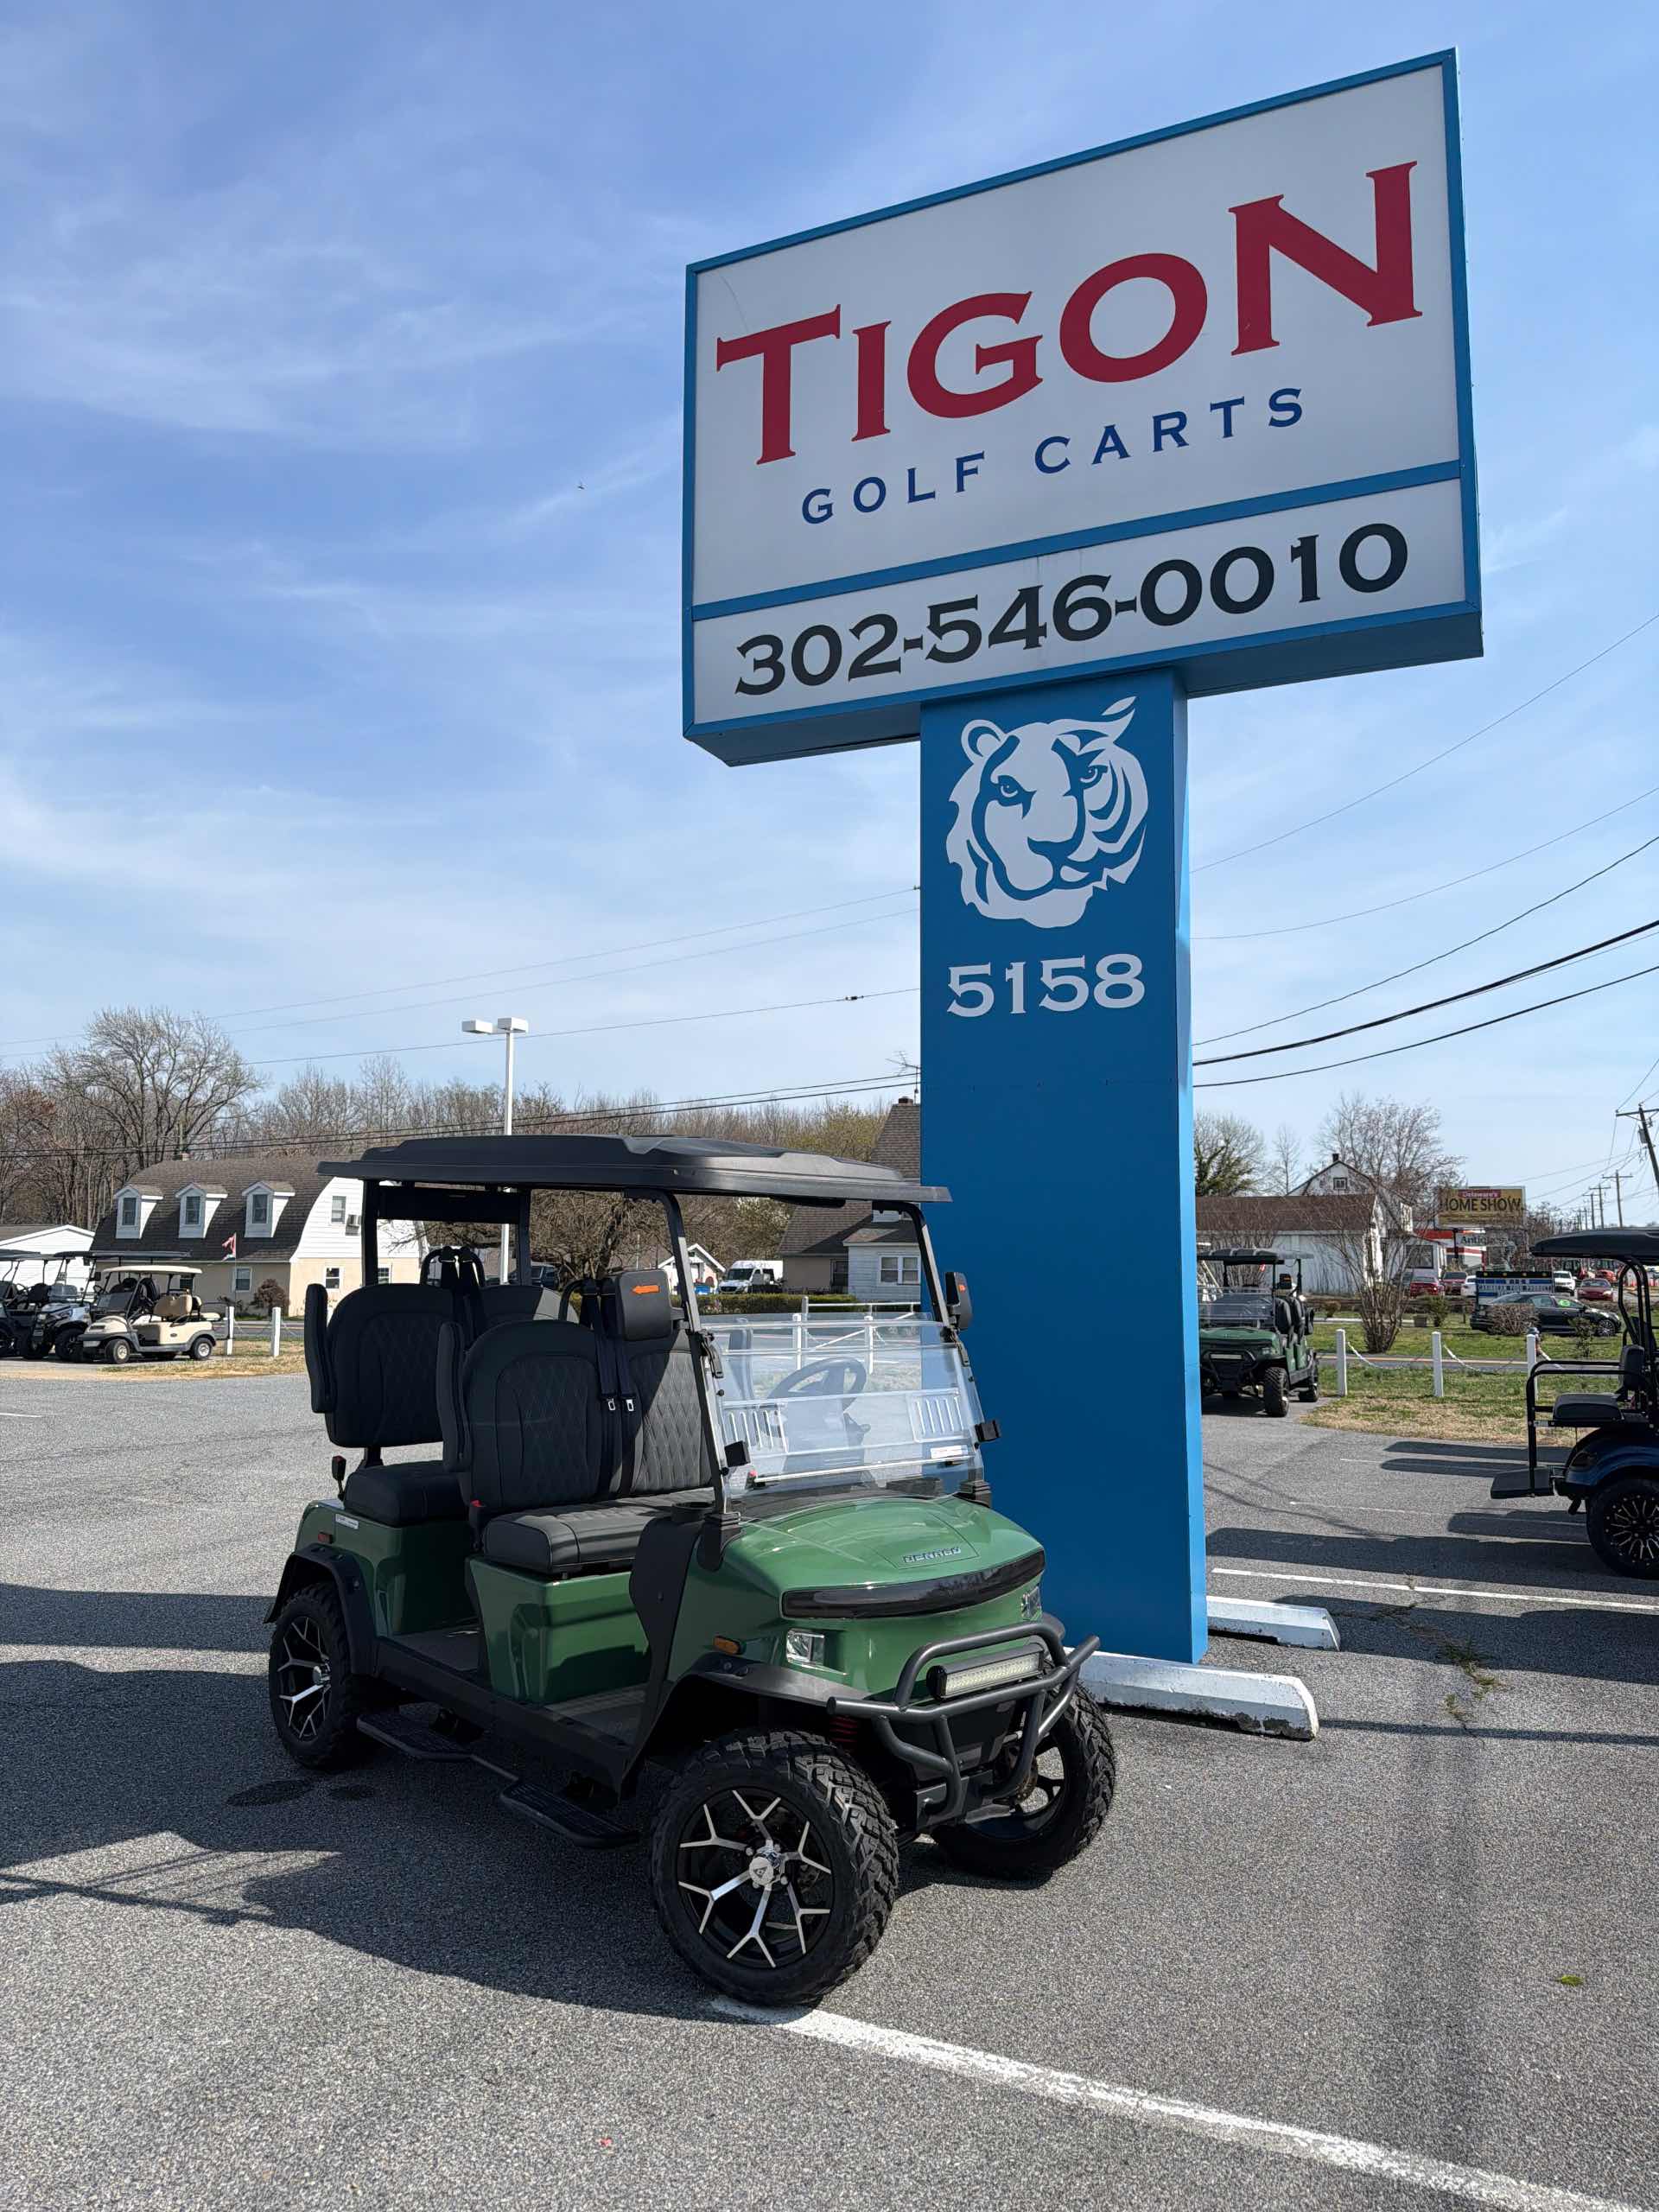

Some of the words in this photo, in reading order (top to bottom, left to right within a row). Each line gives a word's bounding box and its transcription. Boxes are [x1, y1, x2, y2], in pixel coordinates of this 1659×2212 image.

[716, 162, 1421, 465] TIGON
[801, 451, 986, 524] GOLF
[1034, 387, 1304, 475] CARTS
[734, 523, 1409, 696] 302-546-0010
[946, 953, 1146, 1018] 5158
[1480, 1198, 1522, 1212] SHOW
